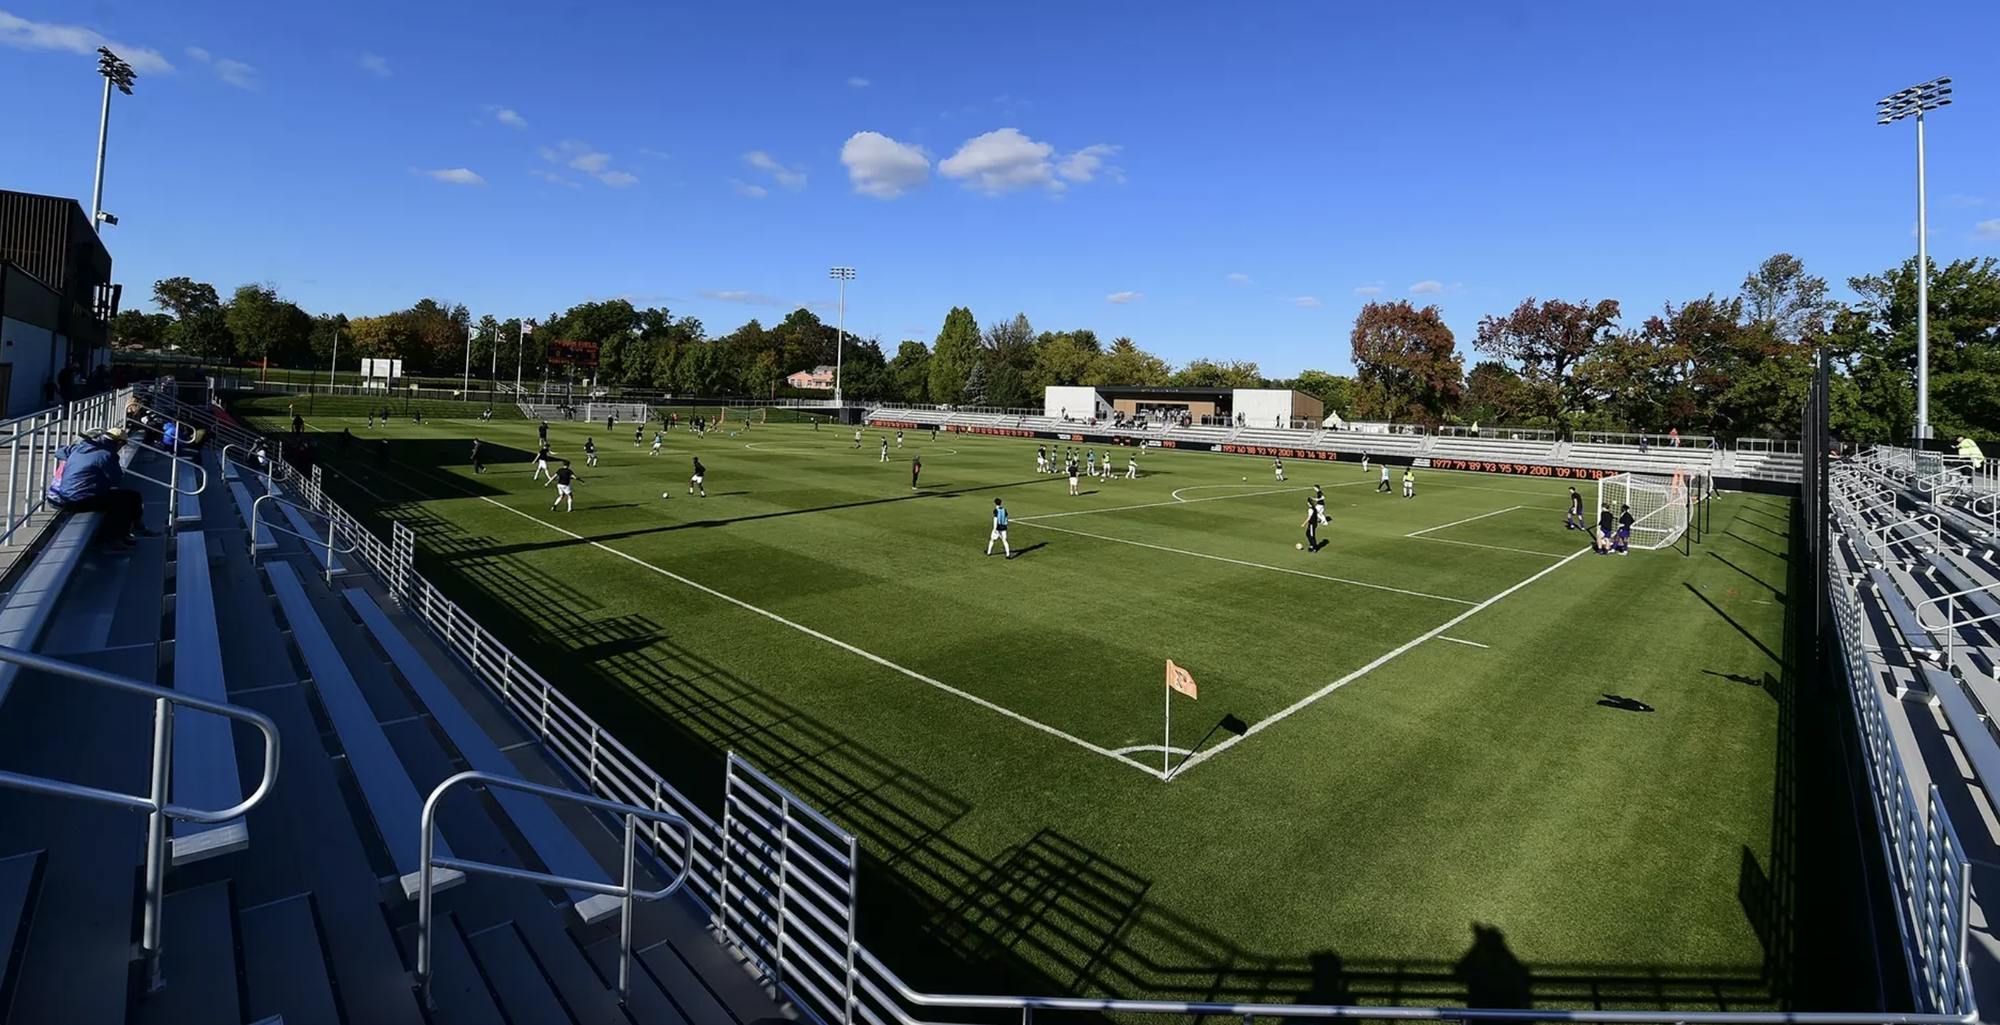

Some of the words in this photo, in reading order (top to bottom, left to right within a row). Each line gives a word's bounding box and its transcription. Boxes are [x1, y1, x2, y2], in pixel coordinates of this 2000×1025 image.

[1163, 440, 1175, 448] 1993
[1278, 448, 1294, 456] 2001
[1433, 459, 1451, 468] 1977
[1453, 460, 1466, 469] '79
[1467, 462, 1481, 470] '89
[1483, 462, 1496, 472] '93
[1498, 463, 1512, 473] '95
[1514, 464, 1527, 474] '99
[1530, 465, 1552, 476] 2001
[1555, 467, 1570, 477] '09
[1572, 468, 1587, 478] '10
[1588, 469, 1603, 480] '18
